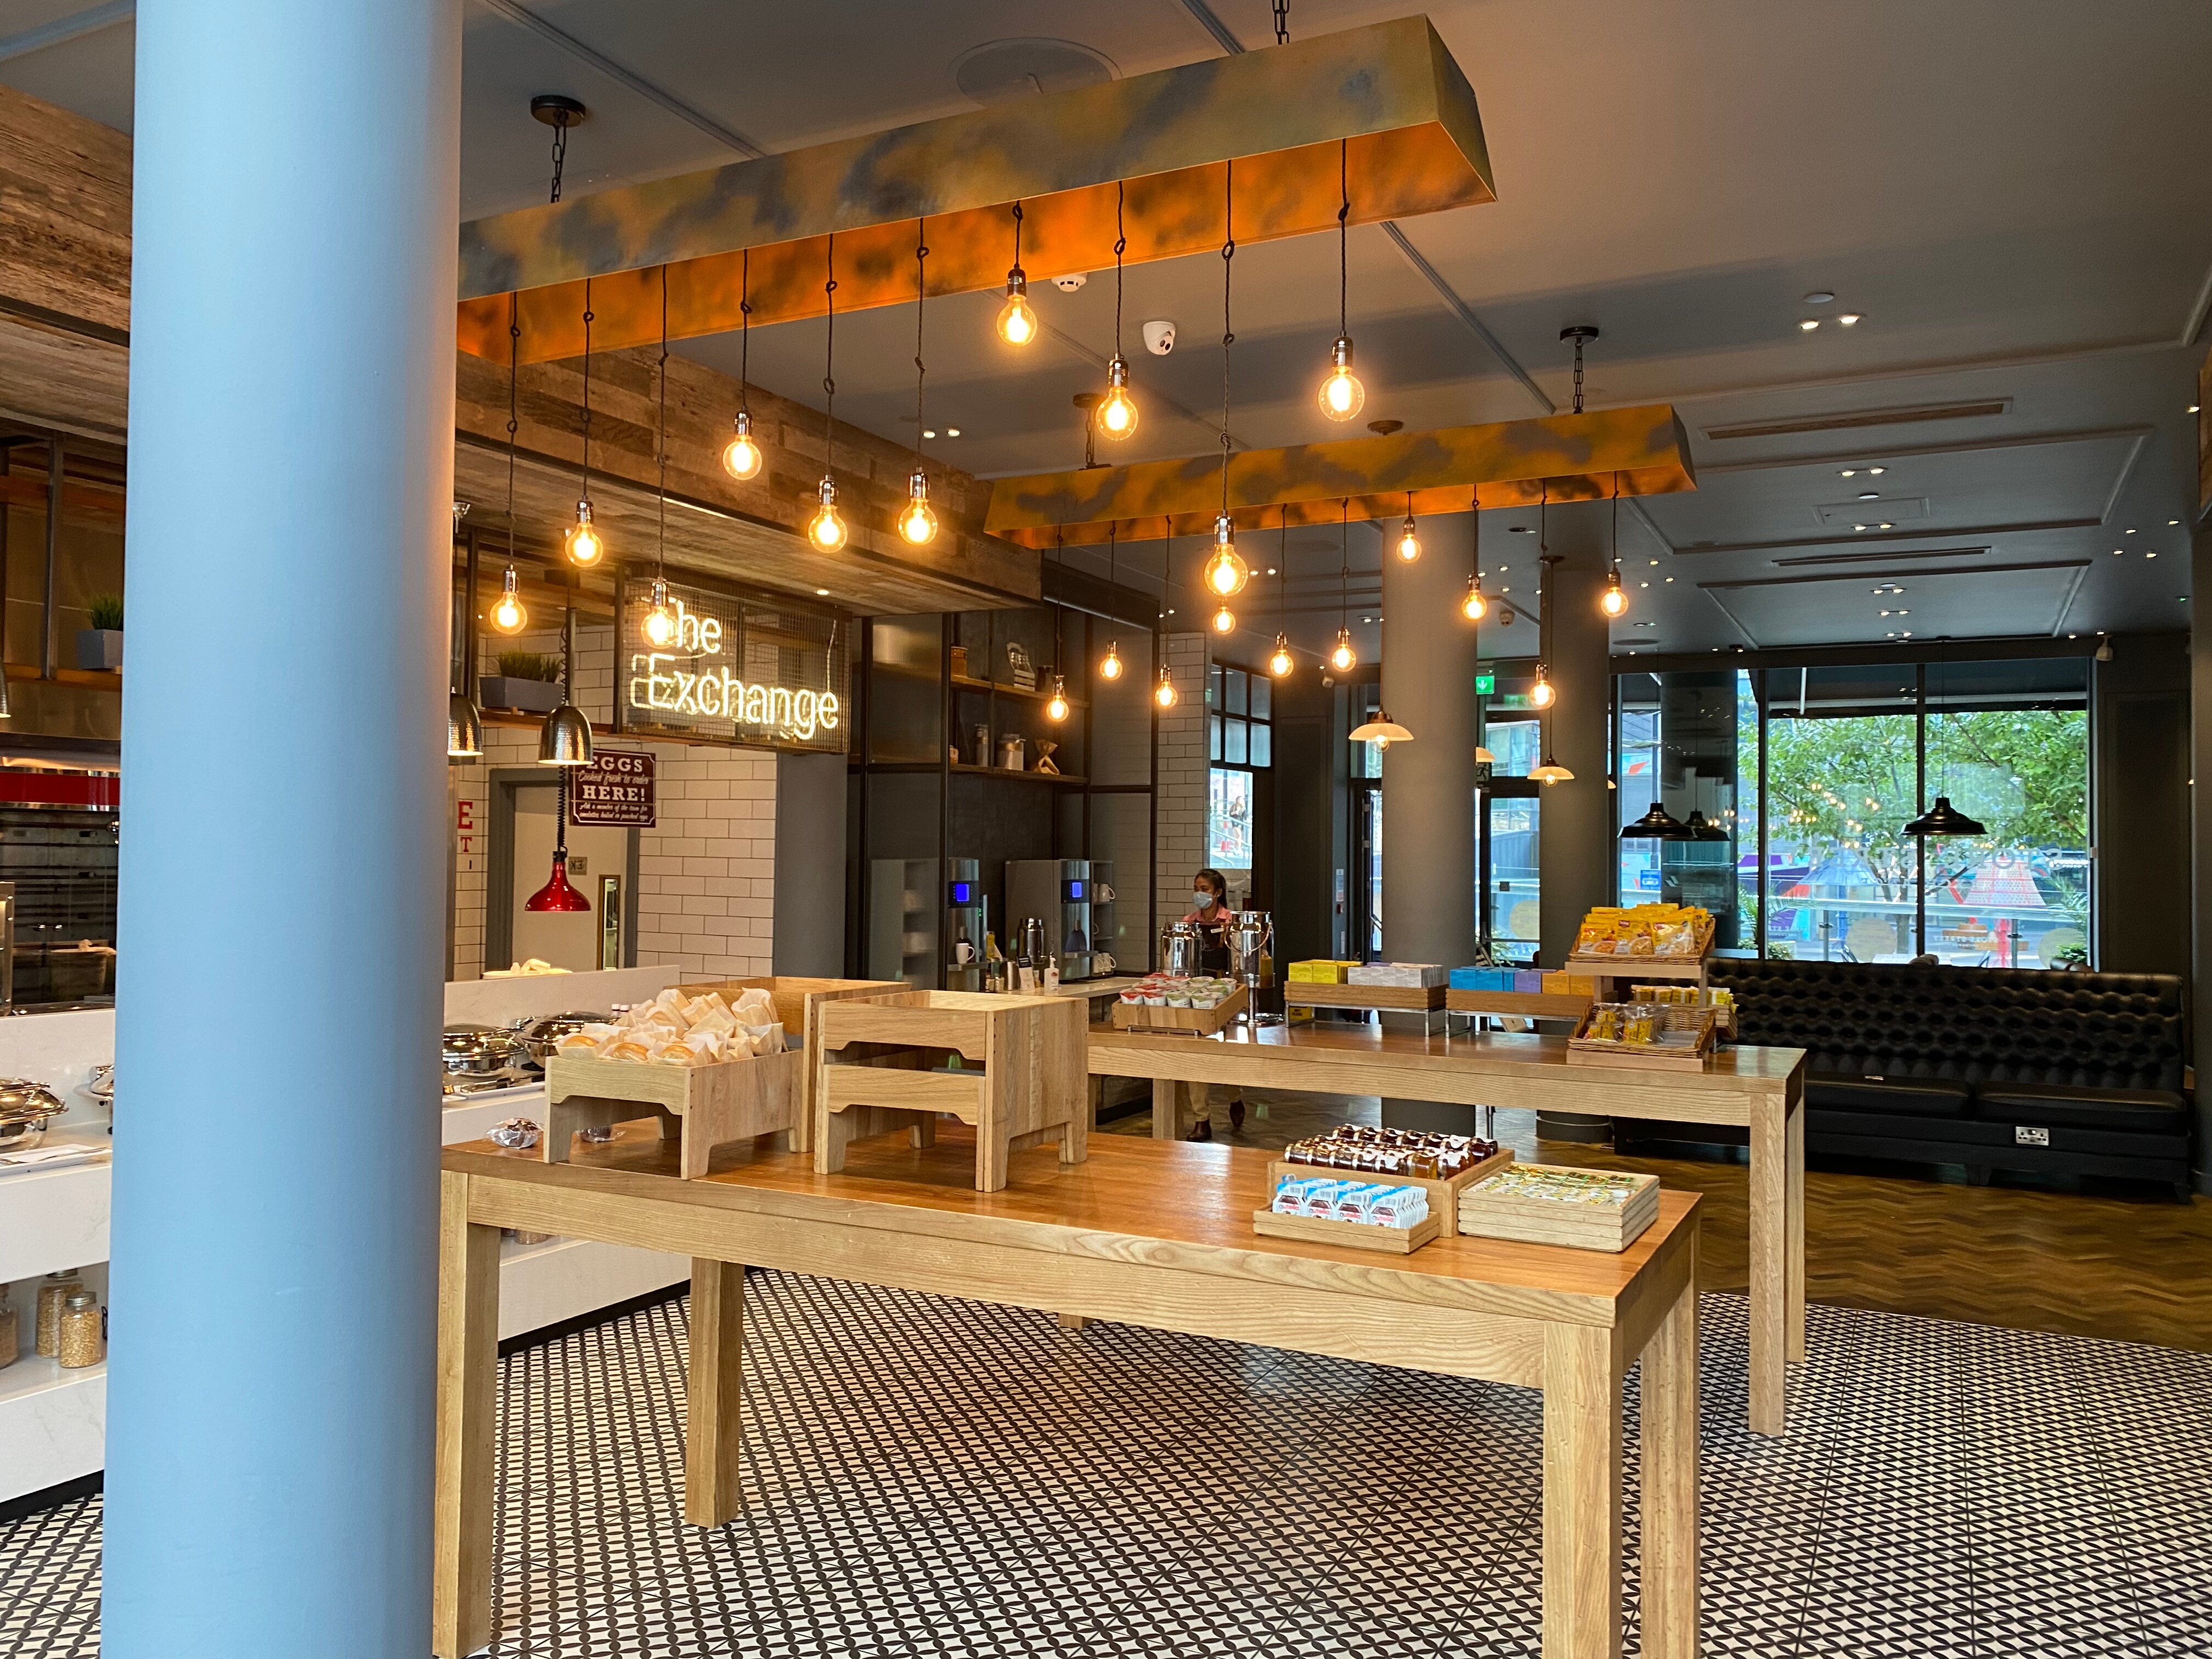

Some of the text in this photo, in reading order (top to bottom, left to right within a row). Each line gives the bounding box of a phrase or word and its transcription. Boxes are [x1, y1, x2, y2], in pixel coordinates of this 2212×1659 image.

[653, 597, 721, 653] he
[648, 652, 839, 740] Exchange
[578, 770, 603, 782] Cooked
[603, 771, 622, 786] fresh
[582, 785, 645, 802] HERE!
